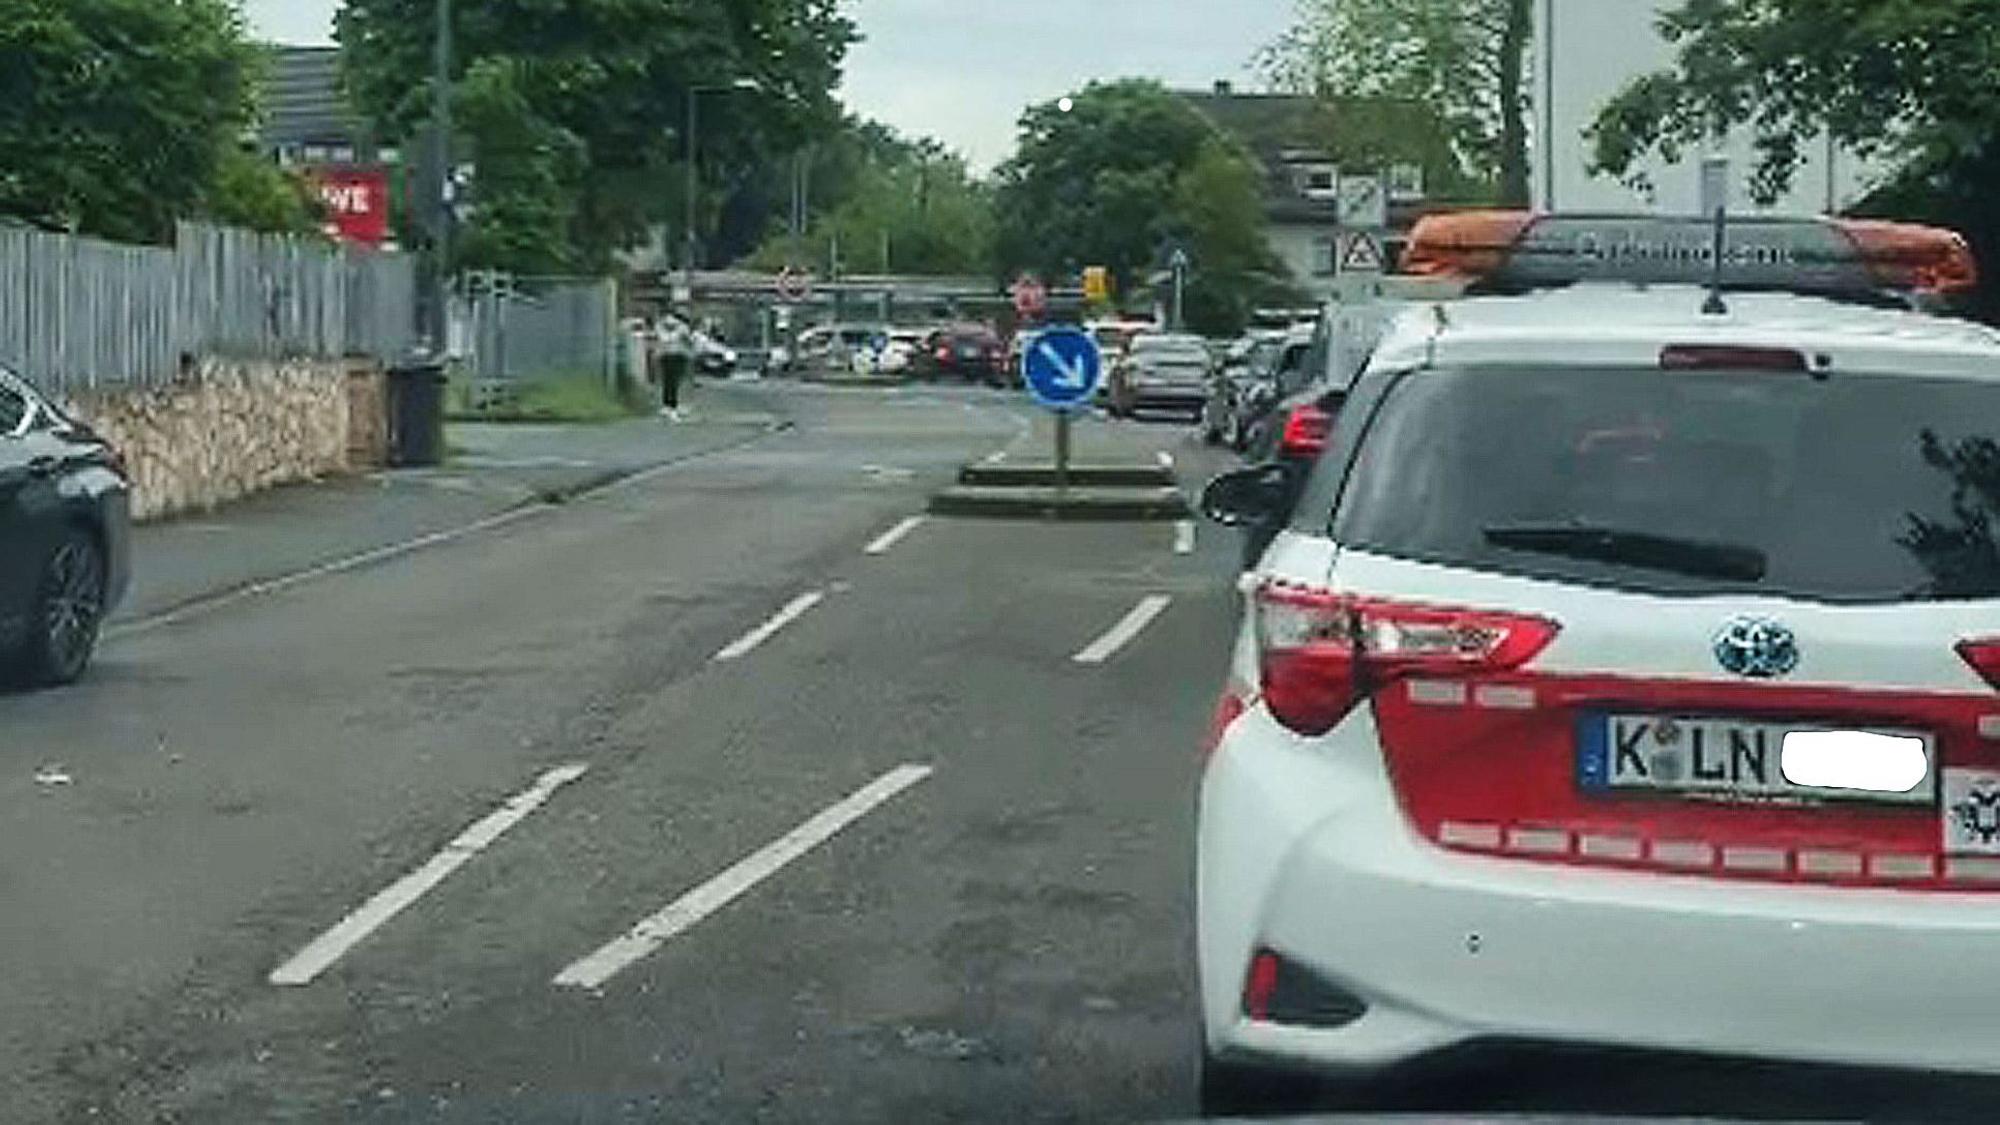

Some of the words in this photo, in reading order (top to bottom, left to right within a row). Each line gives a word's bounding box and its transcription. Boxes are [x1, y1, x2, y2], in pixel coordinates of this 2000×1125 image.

[322, 185, 370, 213] WE
[1615, 720, 1649, 777] K
[1691, 727, 1766, 784] LN
